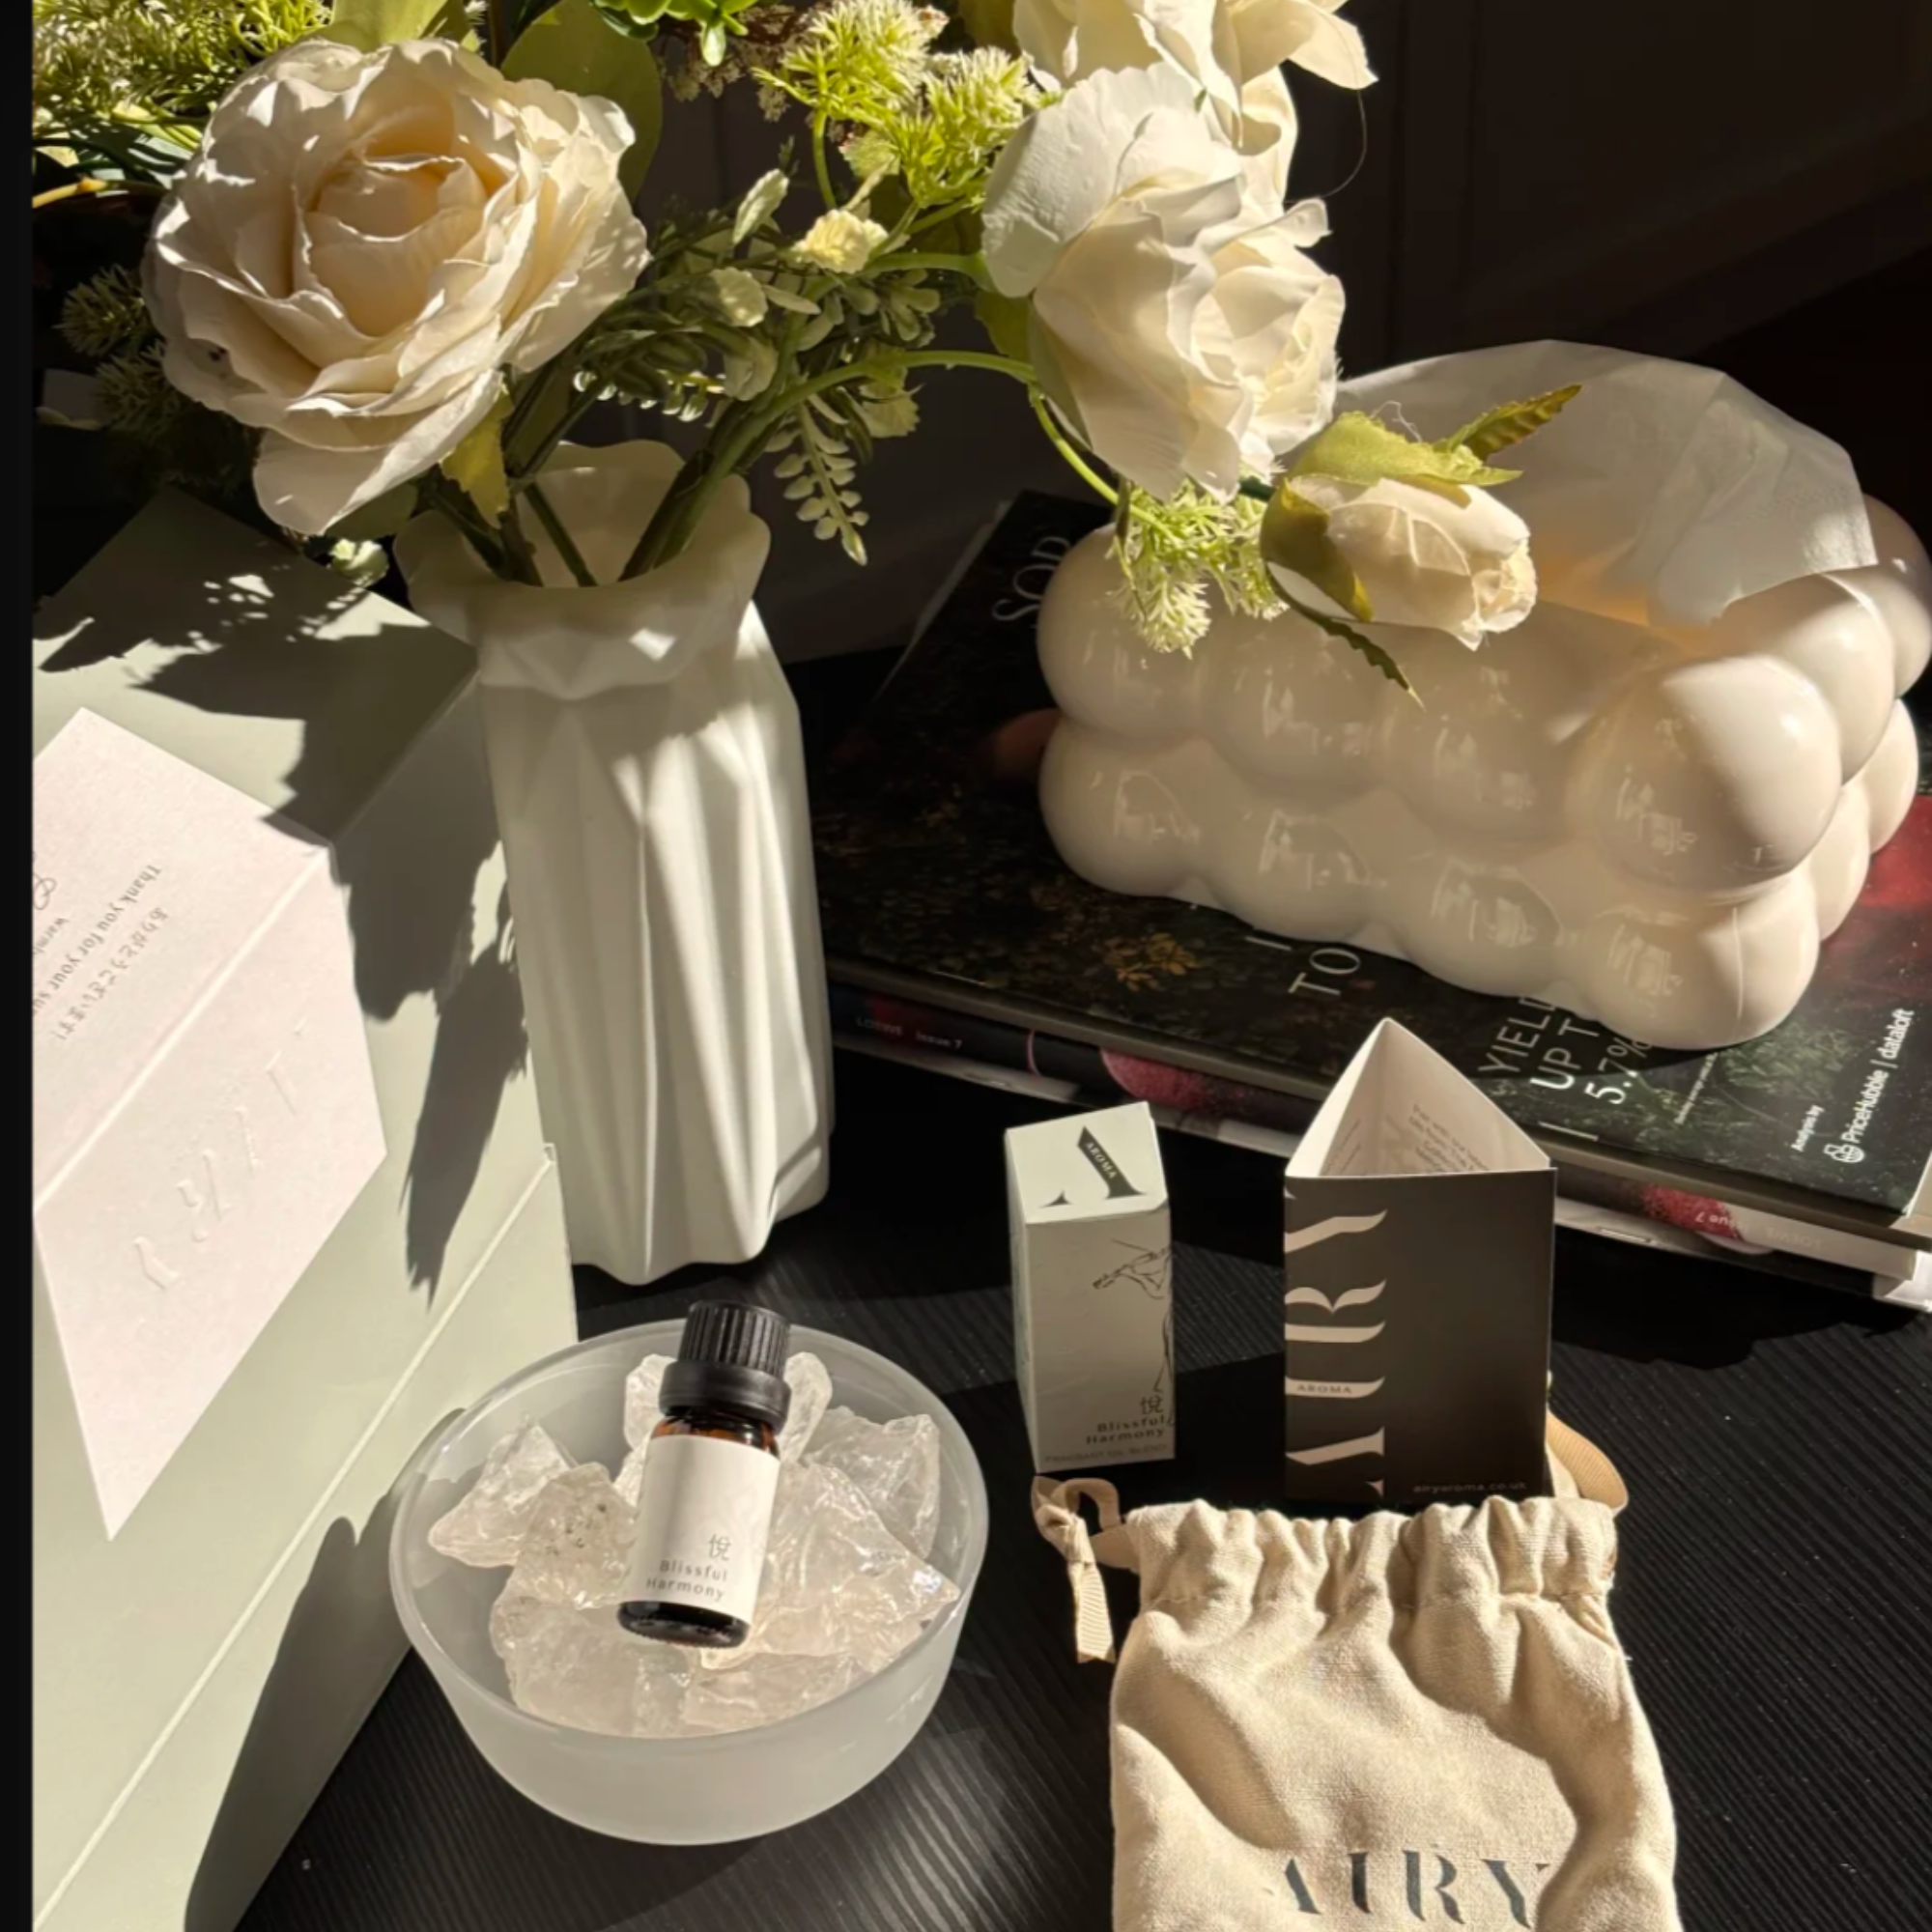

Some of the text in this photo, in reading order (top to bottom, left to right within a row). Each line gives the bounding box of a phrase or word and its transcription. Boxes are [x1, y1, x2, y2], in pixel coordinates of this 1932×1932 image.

[33, 865, 161, 1014] Thank you for your su
[1288, 947, 1361, 997] TO
[1529, 1047, 1581, 1090] UP
[1584, 1037, 1652, 1105] 5.7%
[1840, 1008, 1915, 1144] PriceHubble dataloft
[1085, 1141, 1119, 1179] AROMA
[1297, 1383, 1351, 1394] AROMA
[1086, 1428, 1165, 1445] Harmony
[1095, 1415, 1165, 1433] Blissful
[1413, 1481, 1527, 1494] airyaroma.co.uk
[659, 1558, 728, 1582] Blissful
[646, 1577, 725, 1602] Harmony
[1264, 1849, 1549, 1930] AIRY
